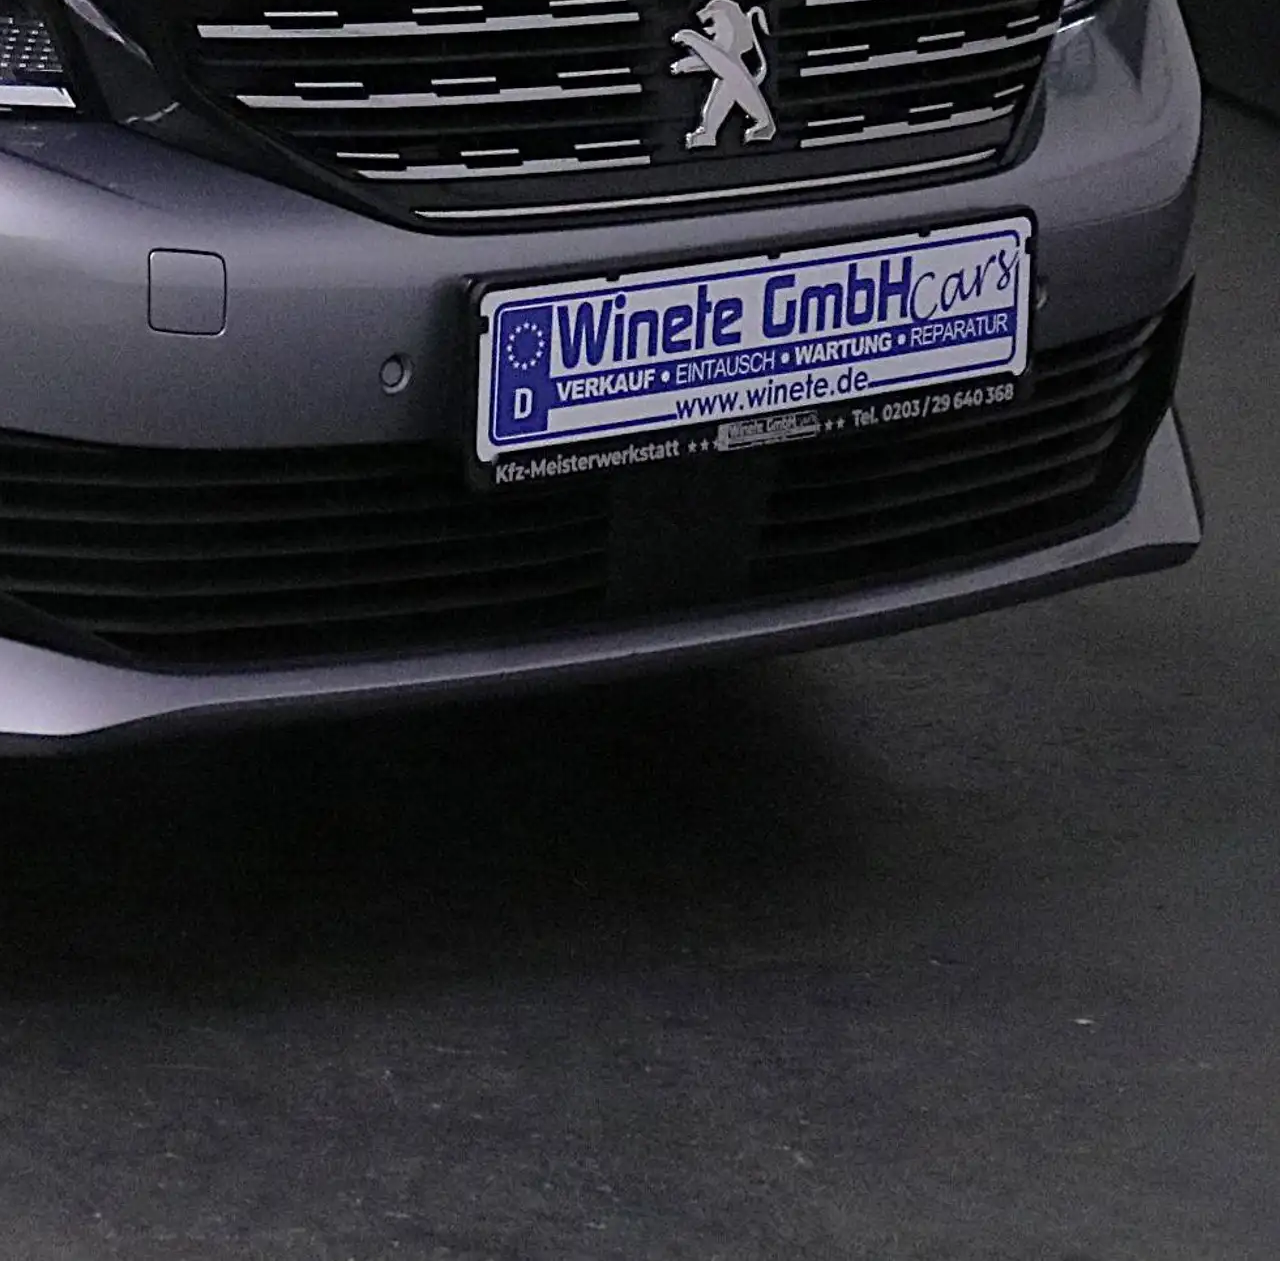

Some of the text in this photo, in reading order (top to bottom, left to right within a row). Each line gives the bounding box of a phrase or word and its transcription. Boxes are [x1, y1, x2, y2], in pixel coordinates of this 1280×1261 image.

[762, 255, 913, 338] GmbH
[556, 313, 1008, 402] VERKAUF EINTAUSCH WARTUNG REPARATUR
[495, 439, 680, 484] Kfz-Meisterwerkstatt
[852, 407, 879, 428] Tel.
[953, 388, 983, 410] 640
[985, 383, 1014, 406] 368
[513, 387, 533, 420] D
